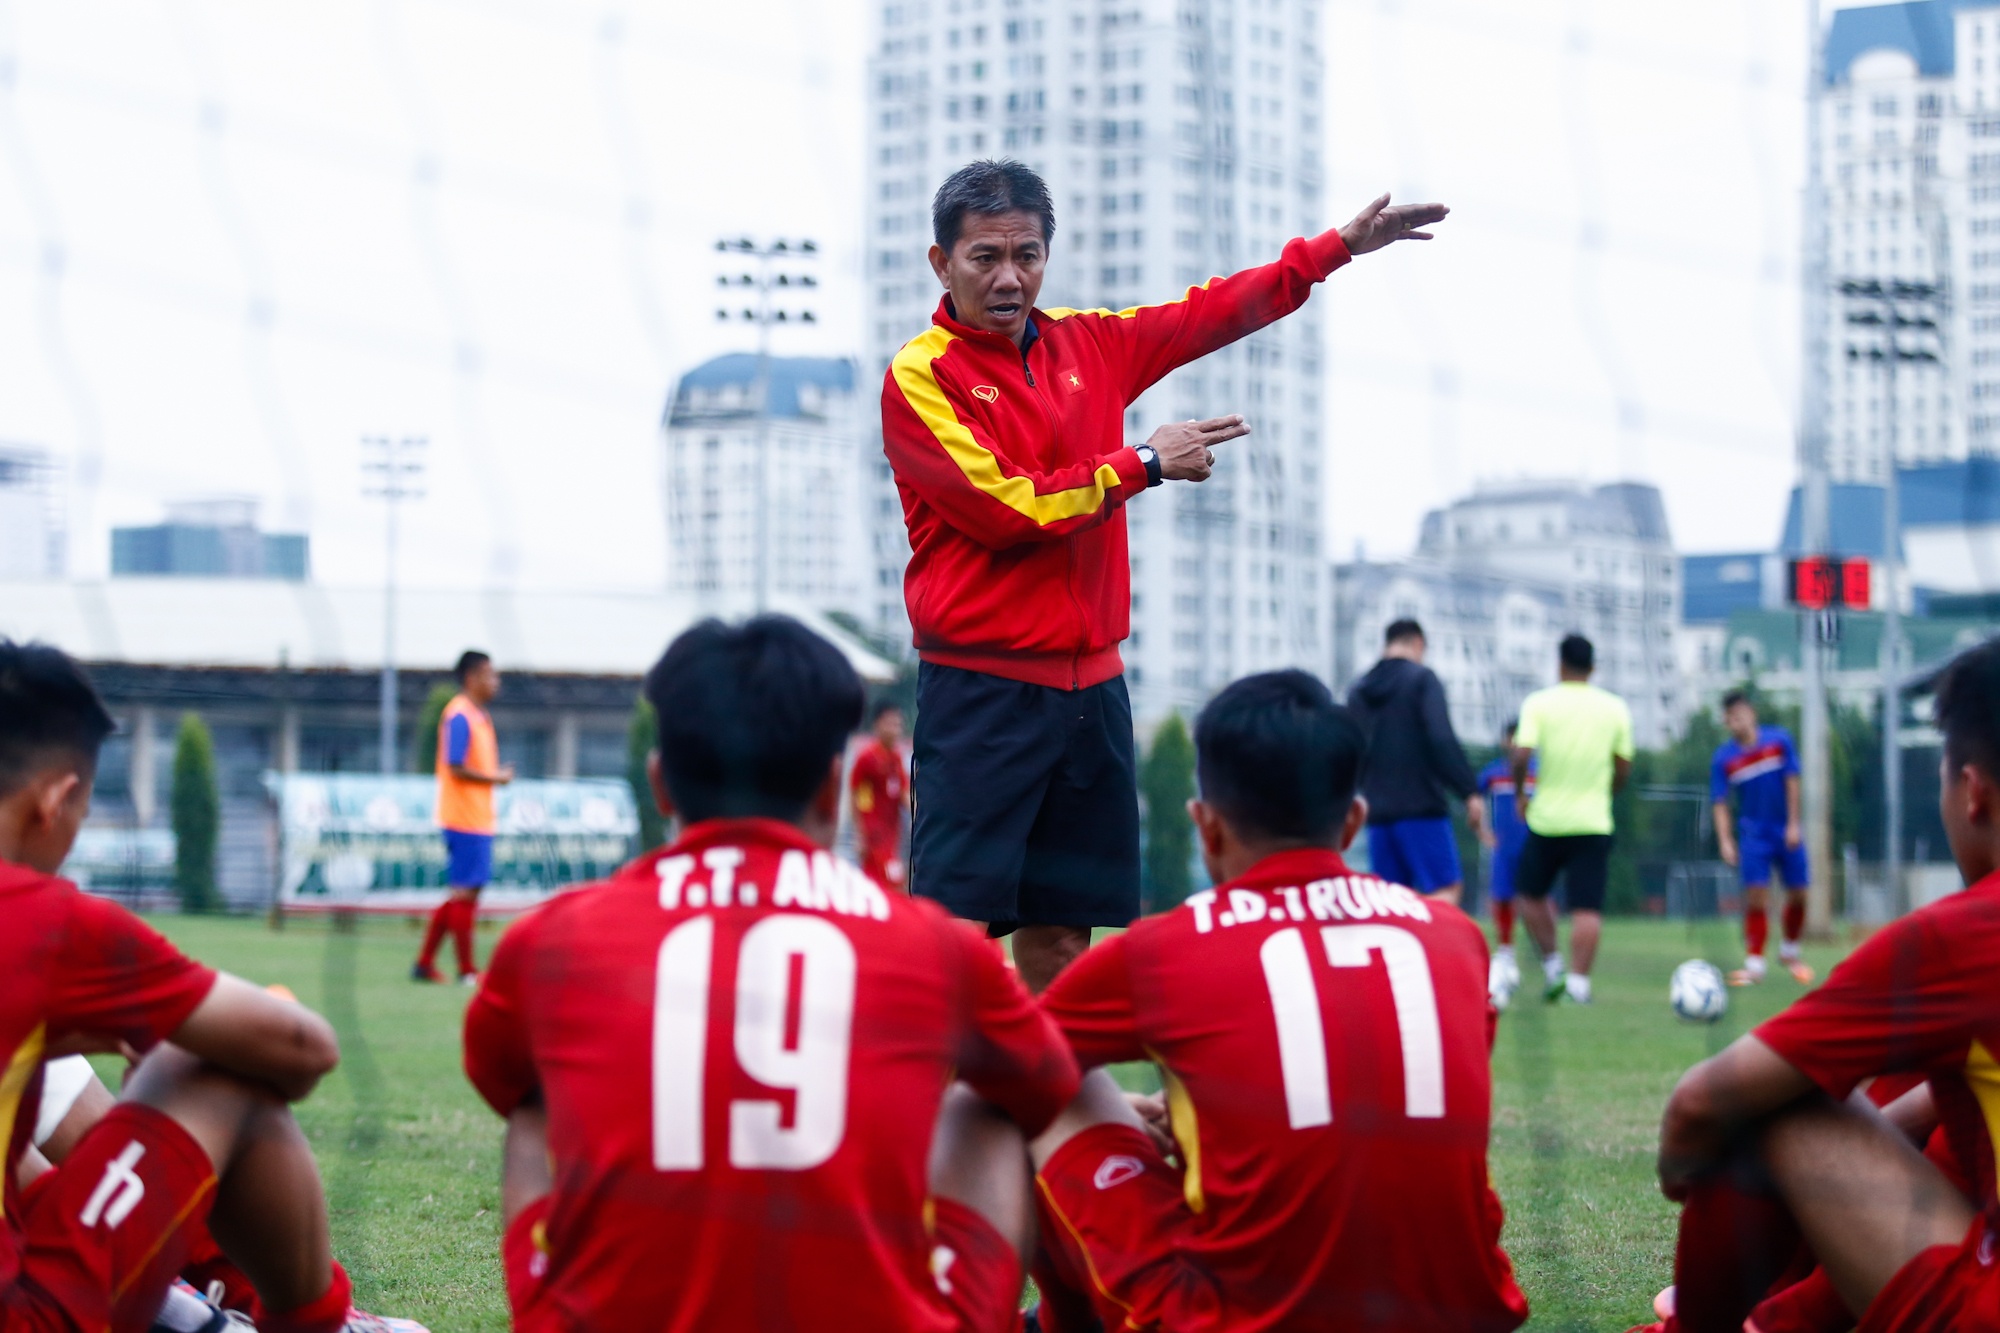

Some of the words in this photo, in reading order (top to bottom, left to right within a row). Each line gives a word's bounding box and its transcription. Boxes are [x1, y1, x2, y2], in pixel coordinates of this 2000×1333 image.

[656, 846, 758, 909] T.T.
[772, 849, 891, 921] ANH
[651, 913, 857, 1172] 19
[1260, 923, 1446, 1131] 17
